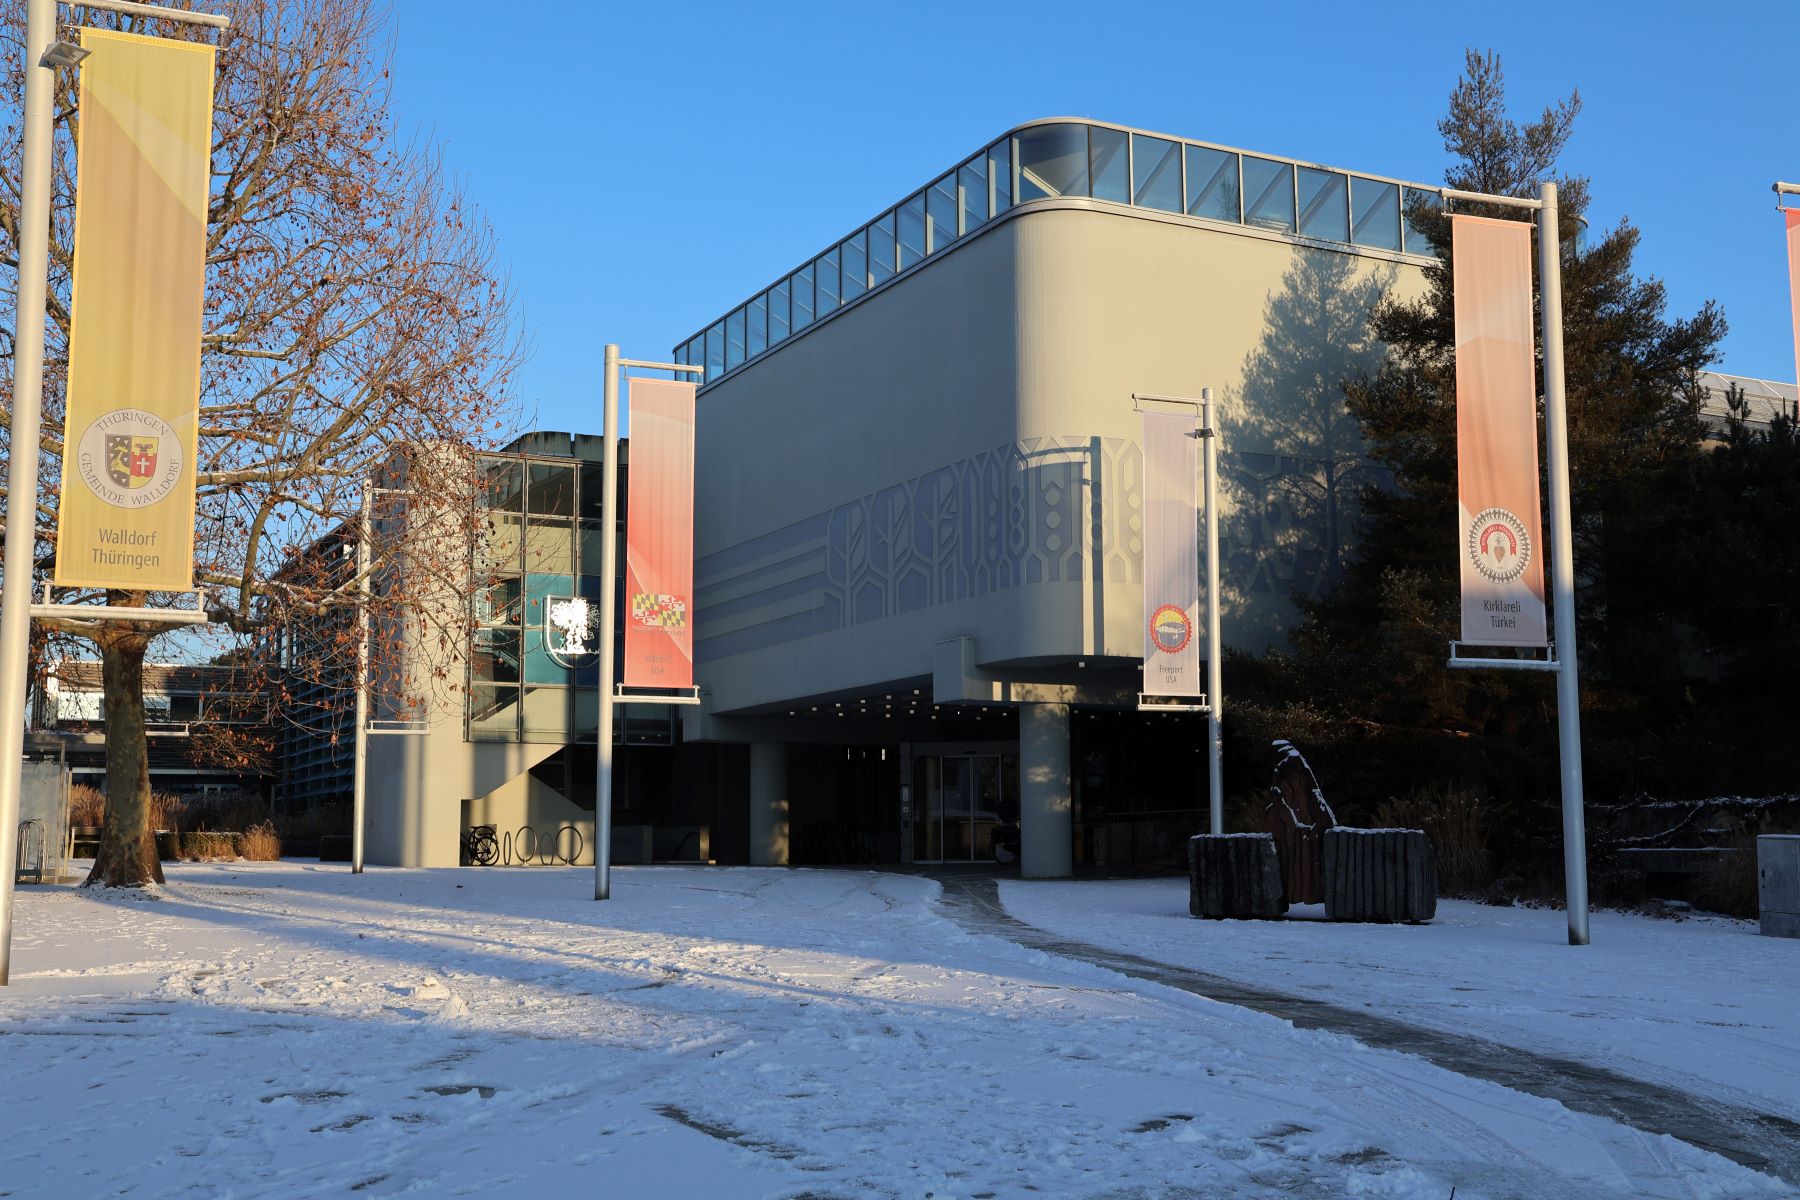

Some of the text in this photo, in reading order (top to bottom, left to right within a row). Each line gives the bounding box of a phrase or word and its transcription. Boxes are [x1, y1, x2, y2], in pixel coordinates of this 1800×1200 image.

[95, 412, 169, 436] THÜRINGEN
[81, 452, 180, 505] GEMEINDE WALLDORF
[99, 528, 157, 546] Walldorf
[92, 549, 160, 569] Thüringen
[1490, 616, 1516, 628] Türkei
[1159, 664, 1183, 675] Freeport
[1165, 675, 1177, 684] USA
